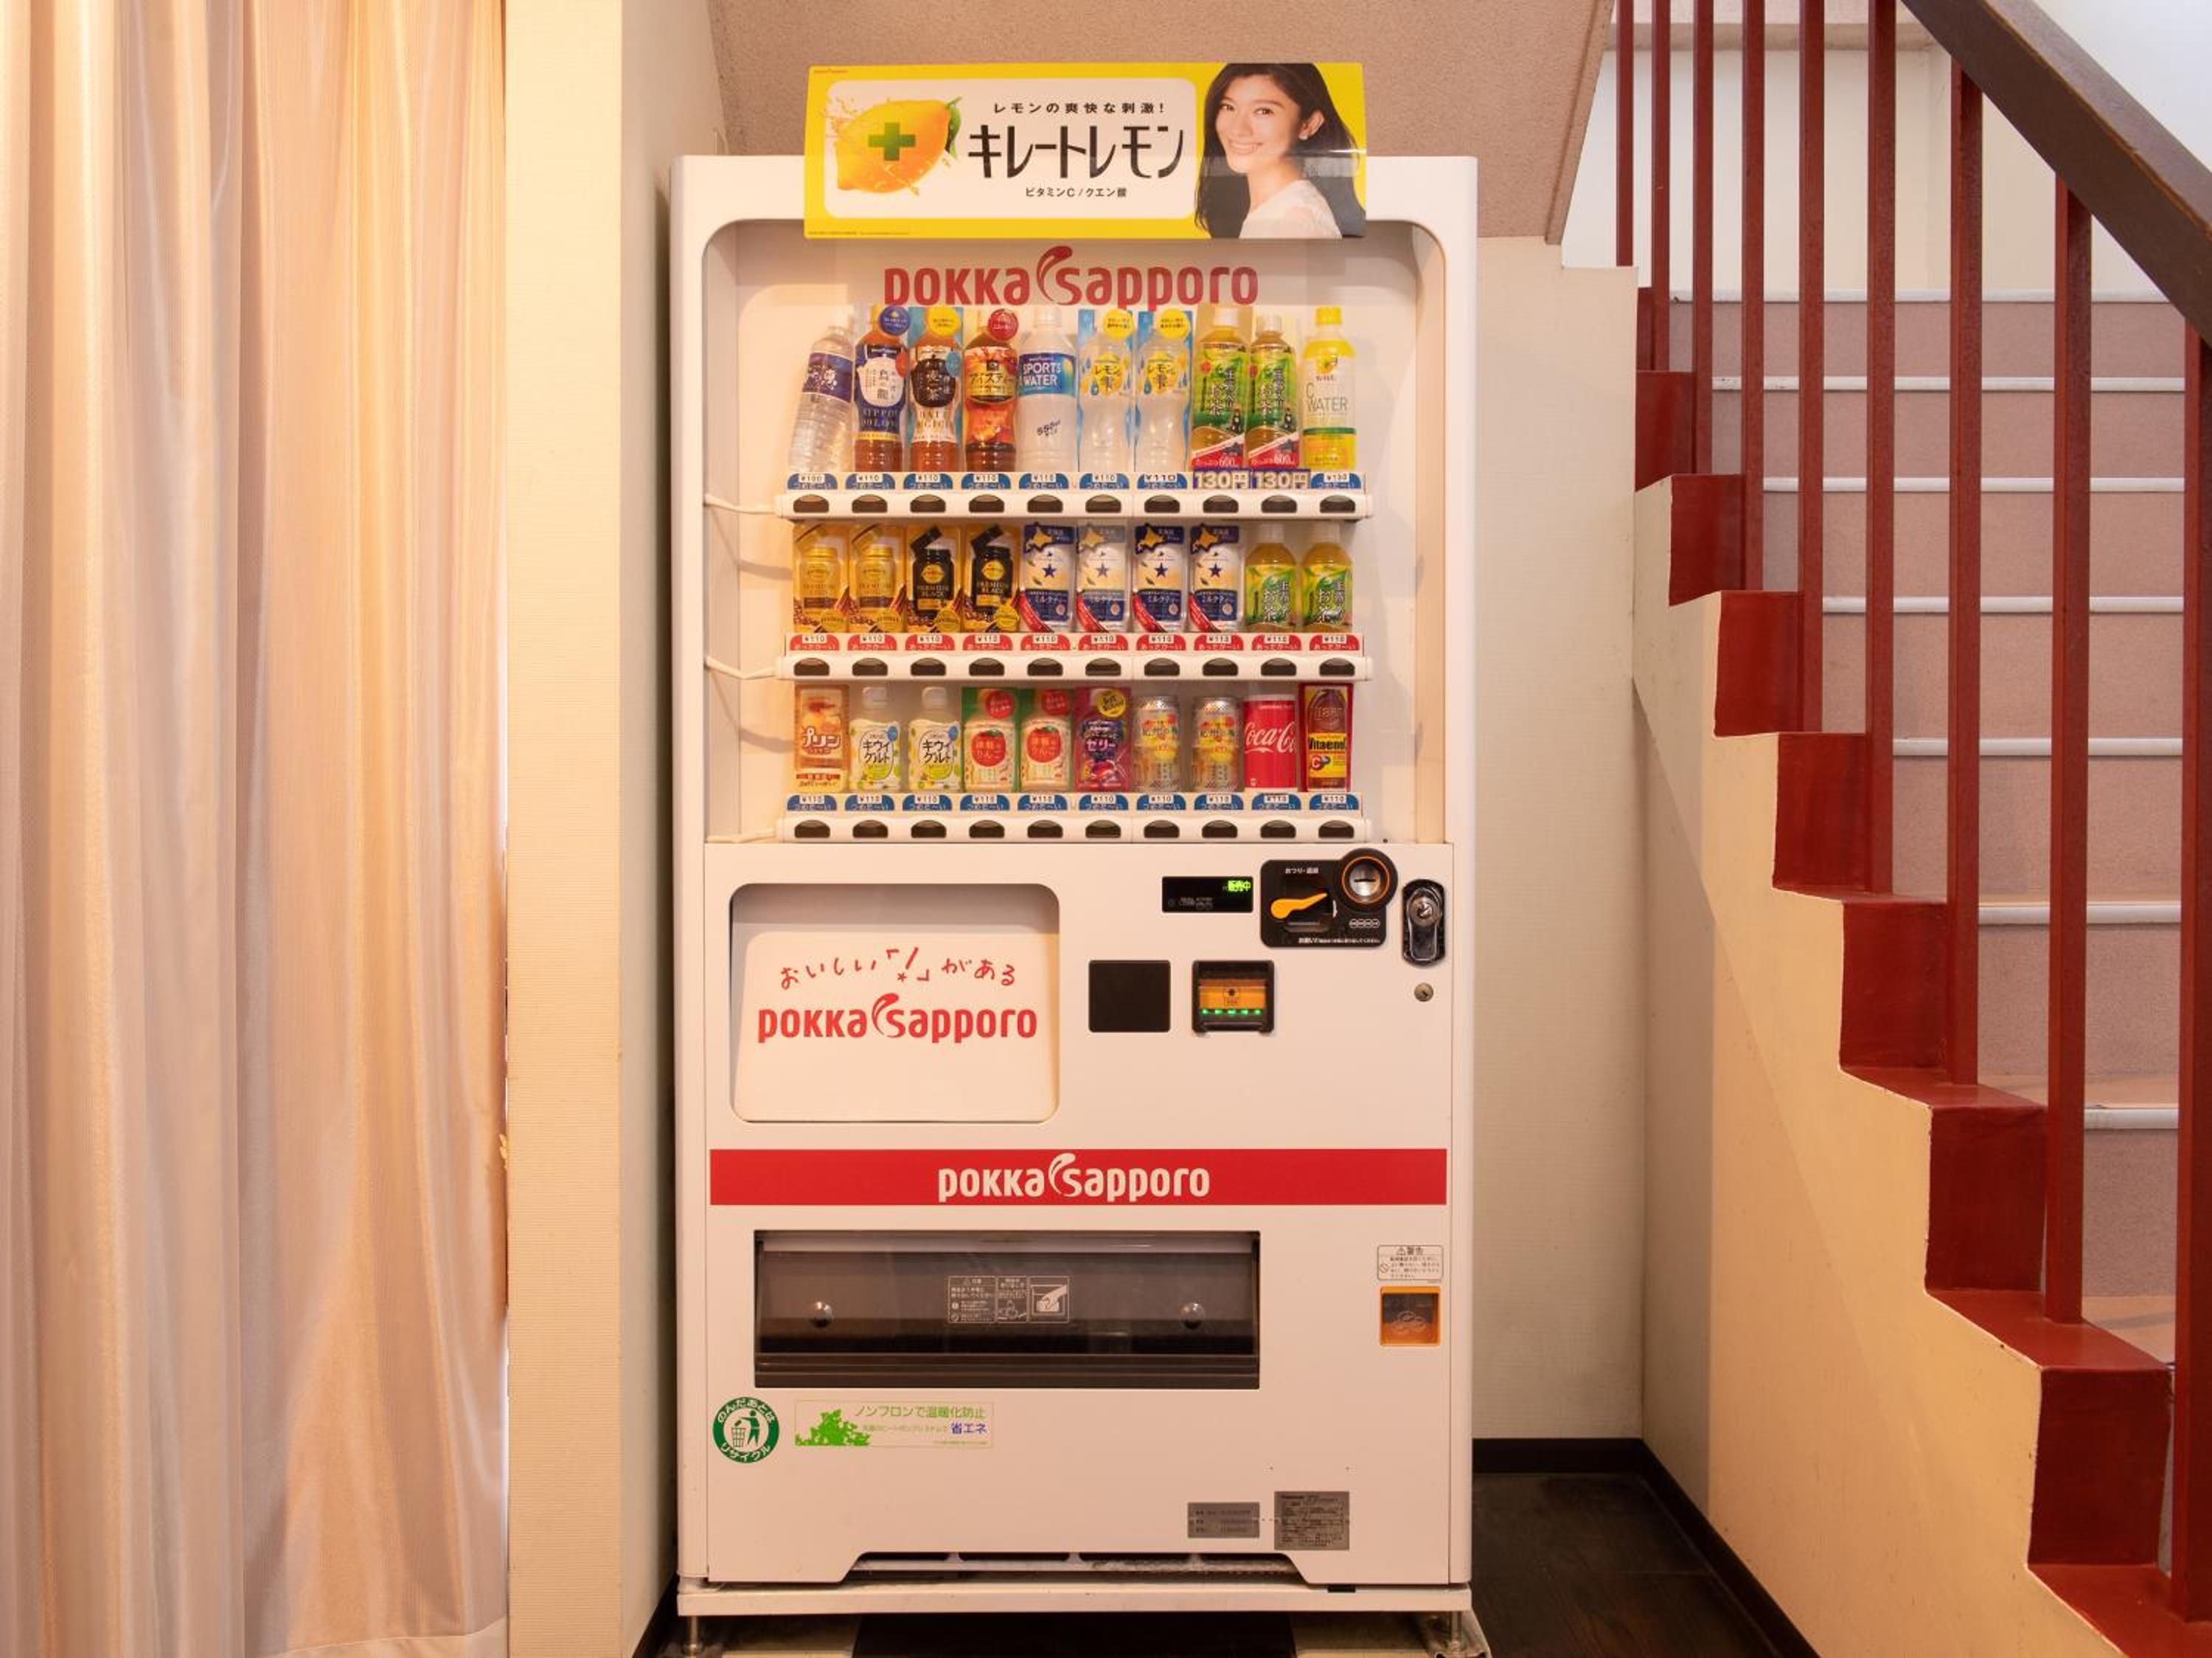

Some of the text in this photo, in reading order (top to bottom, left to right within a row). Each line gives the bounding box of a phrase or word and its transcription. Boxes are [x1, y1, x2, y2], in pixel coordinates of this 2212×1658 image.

[967, 123, 1184, 179] キレートレモン
[1023, 362, 1062, 374] SPORTS
[1023, 374, 1057, 386] WATER
[1307, 397, 1349, 412] WATER
[1195, 471, 1251, 488] 130円
[1254, 471, 1309, 488] 130円
[1086, 739, 1116, 752] ゼリー
[950, 1422, 987, 1435] 省エネ
[720, 1441, 771, 1463] リサイクル
